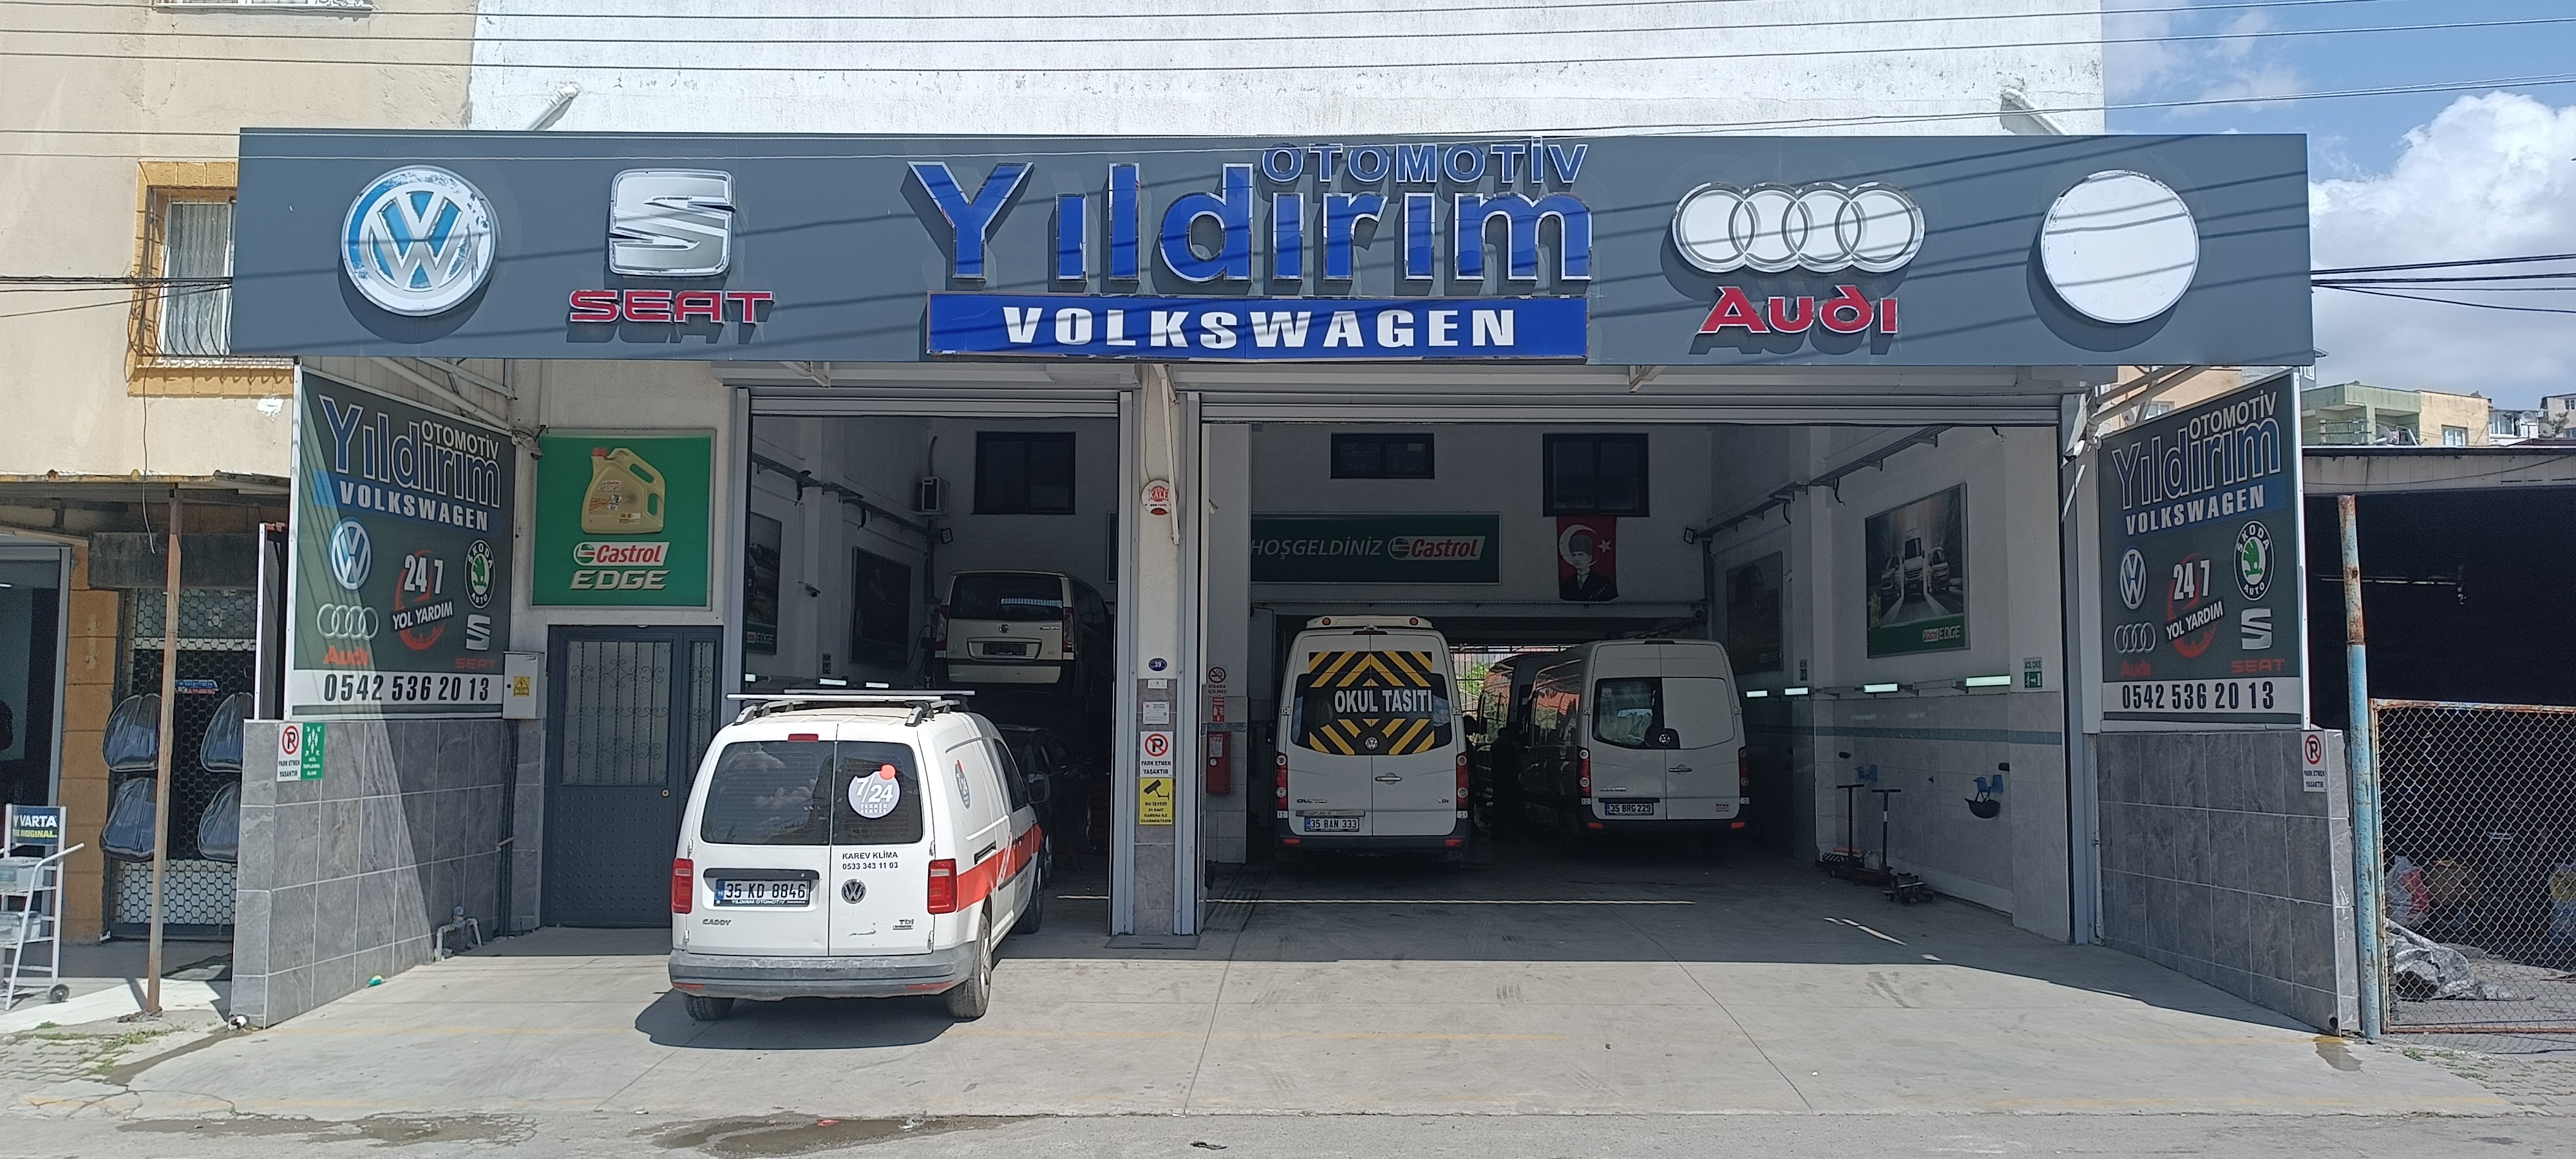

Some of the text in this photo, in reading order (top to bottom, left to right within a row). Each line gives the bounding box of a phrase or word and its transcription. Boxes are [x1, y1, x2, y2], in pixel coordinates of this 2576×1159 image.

[1261, 136, 1589, 184] OTOMOTİV
[907, 161, 1593, 281] Yıldırım
[568, 289, 774, 324] SEAT
[1697, 285, 1898, 334] Audi
[1003, 306, 1515, 349] VOLKSWAGEN
[2190, 390, 2277, 439] OTOMOTİV
[319, 394, 501, 509] Yıldırım
[421, 420, 499, 460] OTOMOTİV
[2111, 418, 2280, 510] Yıldırım
[339, 480, 488, 532] VOLKSWAGEN
[1150, 490, 1168, 500] KALE
[2126, 484, 2264, 535] VOLKSWAGEN
[596, 544, 661, 563] Castrol
[1250, 536, 1478, 560] HOŞGELDİNİZ Castrol
[404, 554, 444, 594] 24 7
[569, 570, 670, 590] EDGE
[2173, 560, 2210, 599] 24 7
[471, 592, 488, 604] AUTO
[2244, 581, 2265, 596] AUTO
[392, 601, 453, 630] YOL YARDIM
[2166, 601, 2224, 640] YOL YARDIM
[1939, 625, 1961, 640] EDGE
[323, 645, 370, 666] Audi
[455, 658, 497, 670] SEAT
[2231, 659, 2285, 673] SEAT
[324, 674, 489, 701] 0542 536 20 13
[1334, 690, 1432, 713] OKUL TASITI
[2122, 681, 2273, 709] 0542 536 20 13
[857, 775, 893, 803] 7/24
[19, 815, 57, 827] VARTA
[1311, 819, 1356, 828] 35 BAN 333
[873, 851, 898, 859] KLİMA
[726, 883, 805, 898] 35 KD 8846
